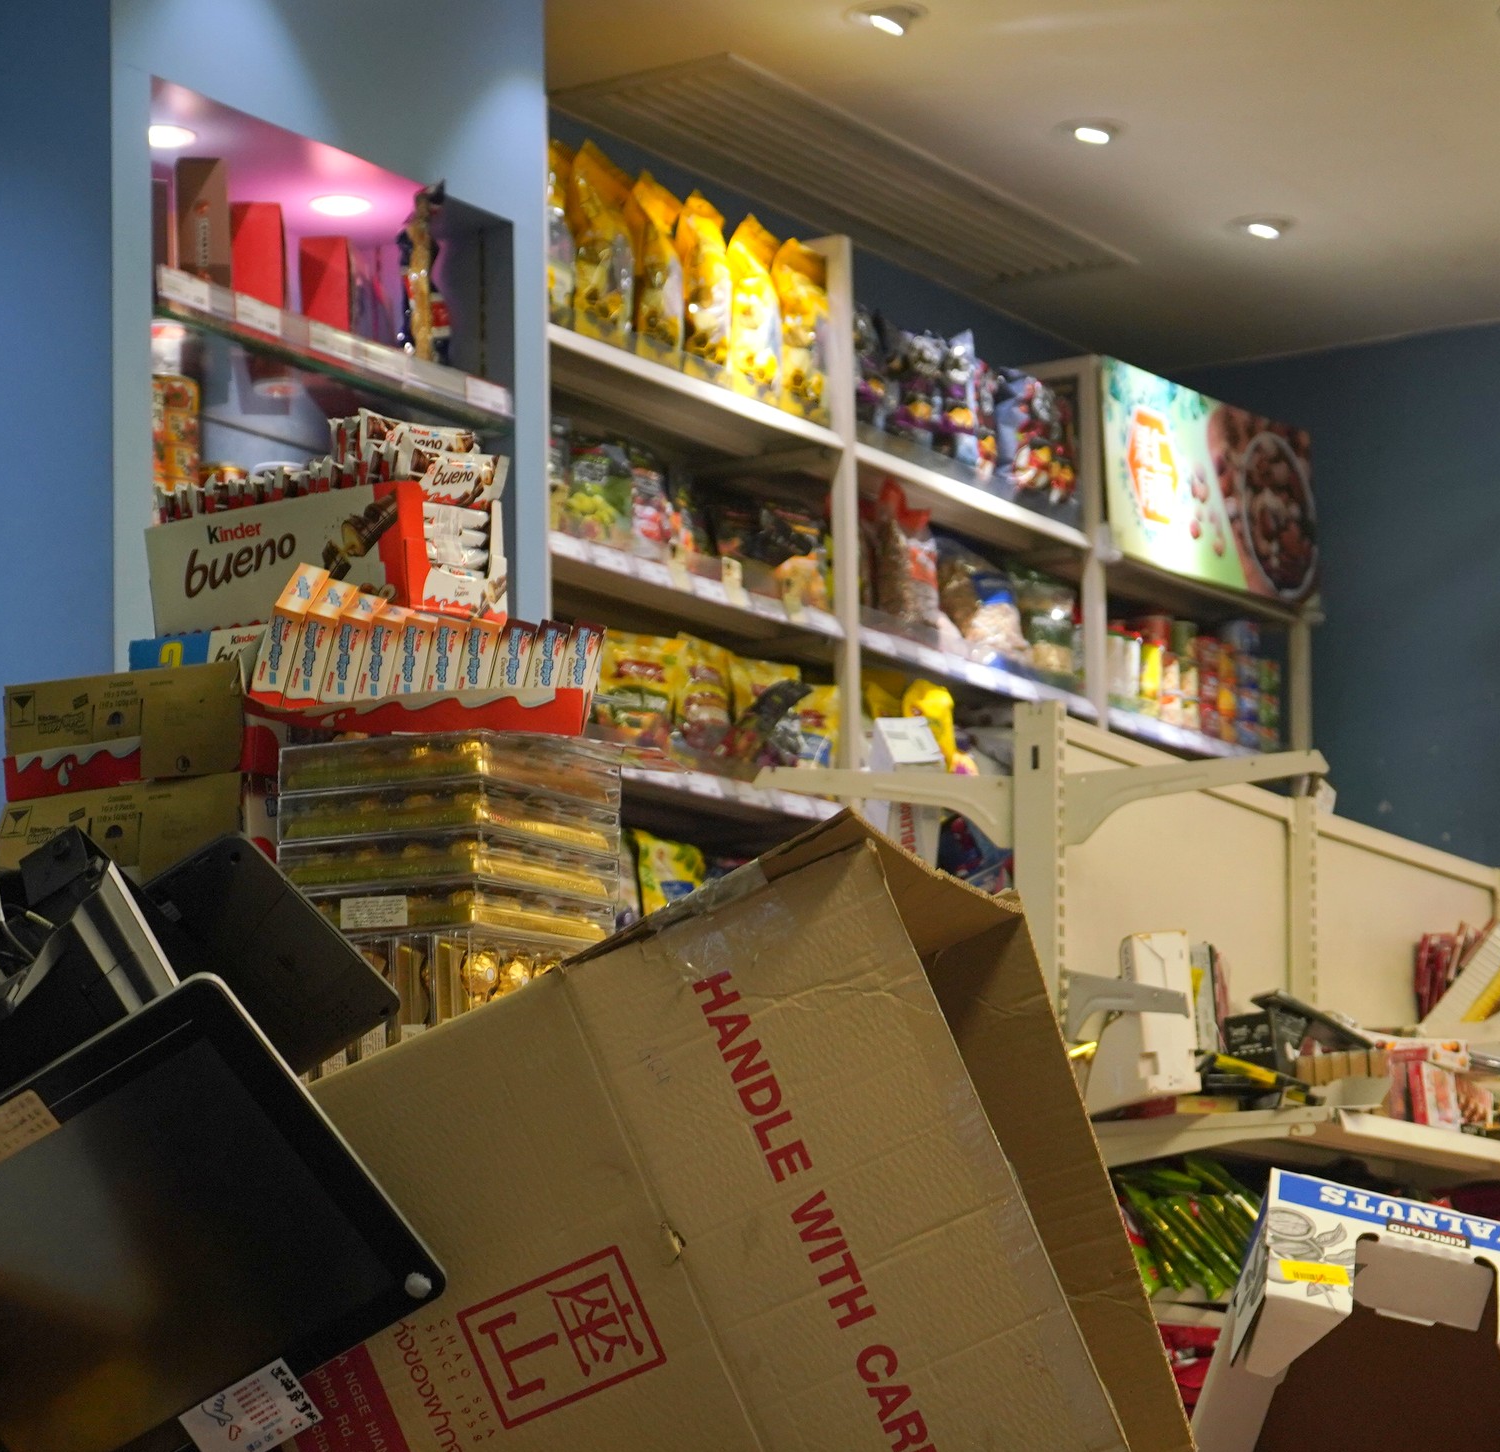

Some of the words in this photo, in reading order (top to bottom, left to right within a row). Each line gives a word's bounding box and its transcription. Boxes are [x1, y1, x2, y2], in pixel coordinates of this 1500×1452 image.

[432, 465, 474, 487] bueno
[206, 521, 263, 545] Kinder
[184, 532, 297, 599] bueno
[693, 970, 813, 1183] HANDLE
[790, 1190, 877, 1330] WITH
[1389, 1222, 1468, 1248] KIRKLAND
[342, 1371, 372, 1418] NGEE
[424, 1324, 457, 1384] SINCE
[455, 1394, 484, 1444] 1958
[437, 1318, 472, 1380] CHAO
[472, 1395, 498, 1438] SUA
